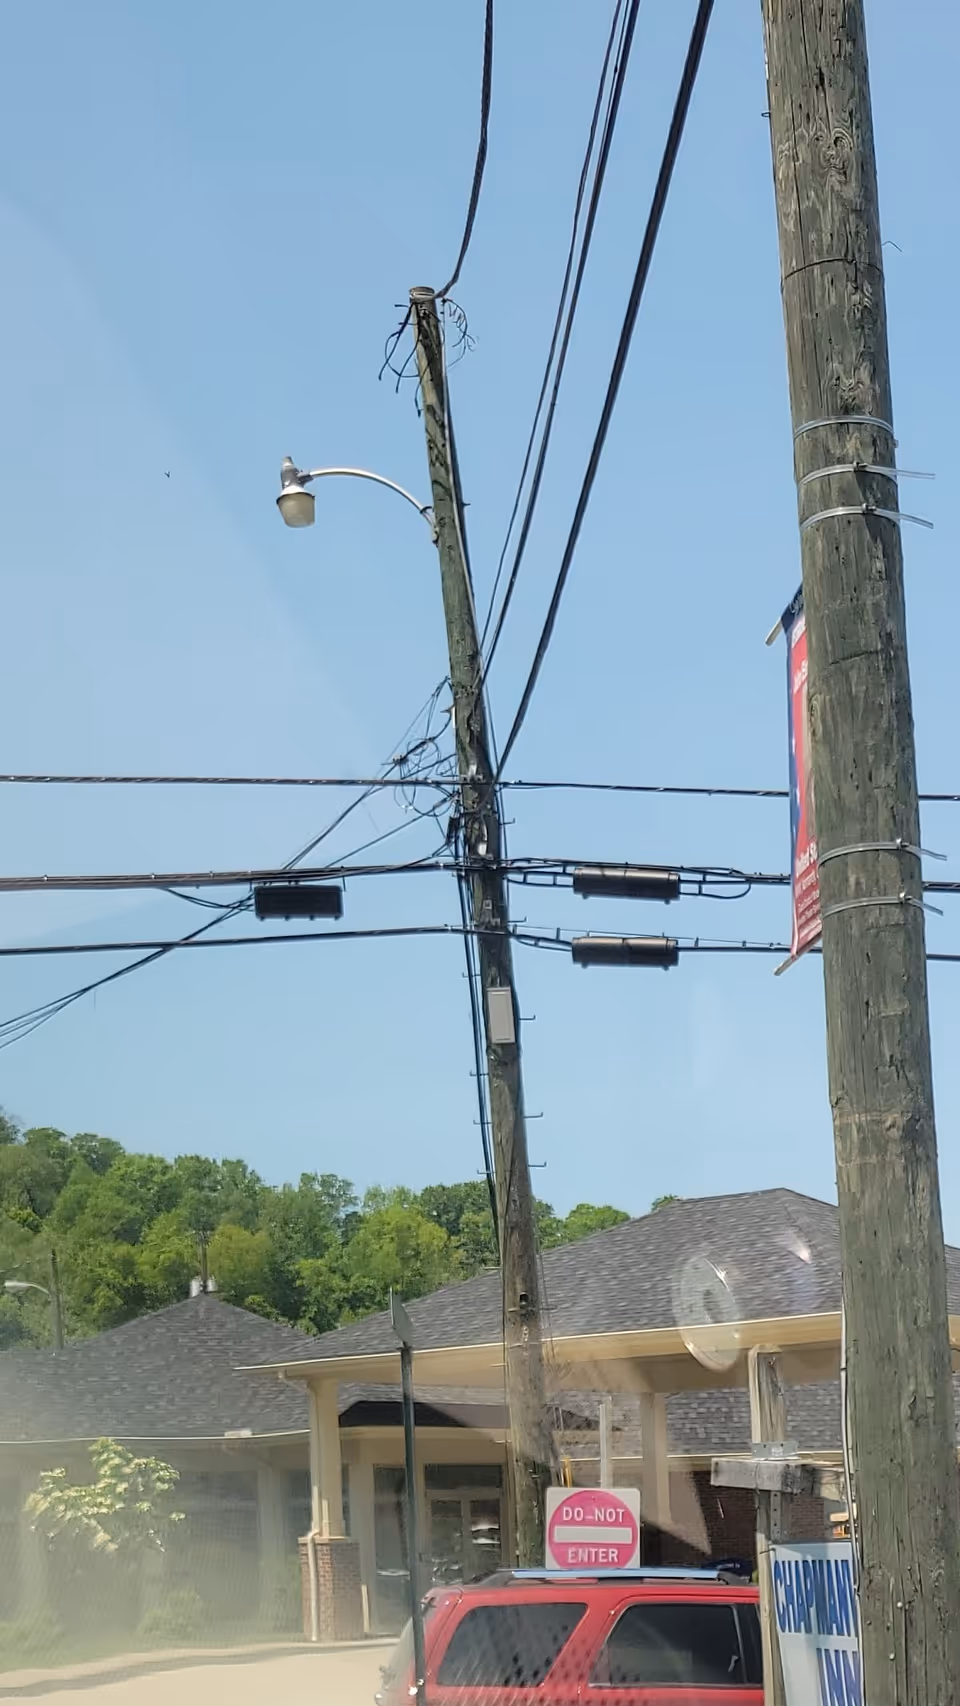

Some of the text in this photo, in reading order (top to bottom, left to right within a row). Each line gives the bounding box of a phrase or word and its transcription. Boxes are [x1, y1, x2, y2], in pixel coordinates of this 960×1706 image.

[562, 1506, 625, 1523] DO NOT
[567, 1547, 618, 1564] ENTER
